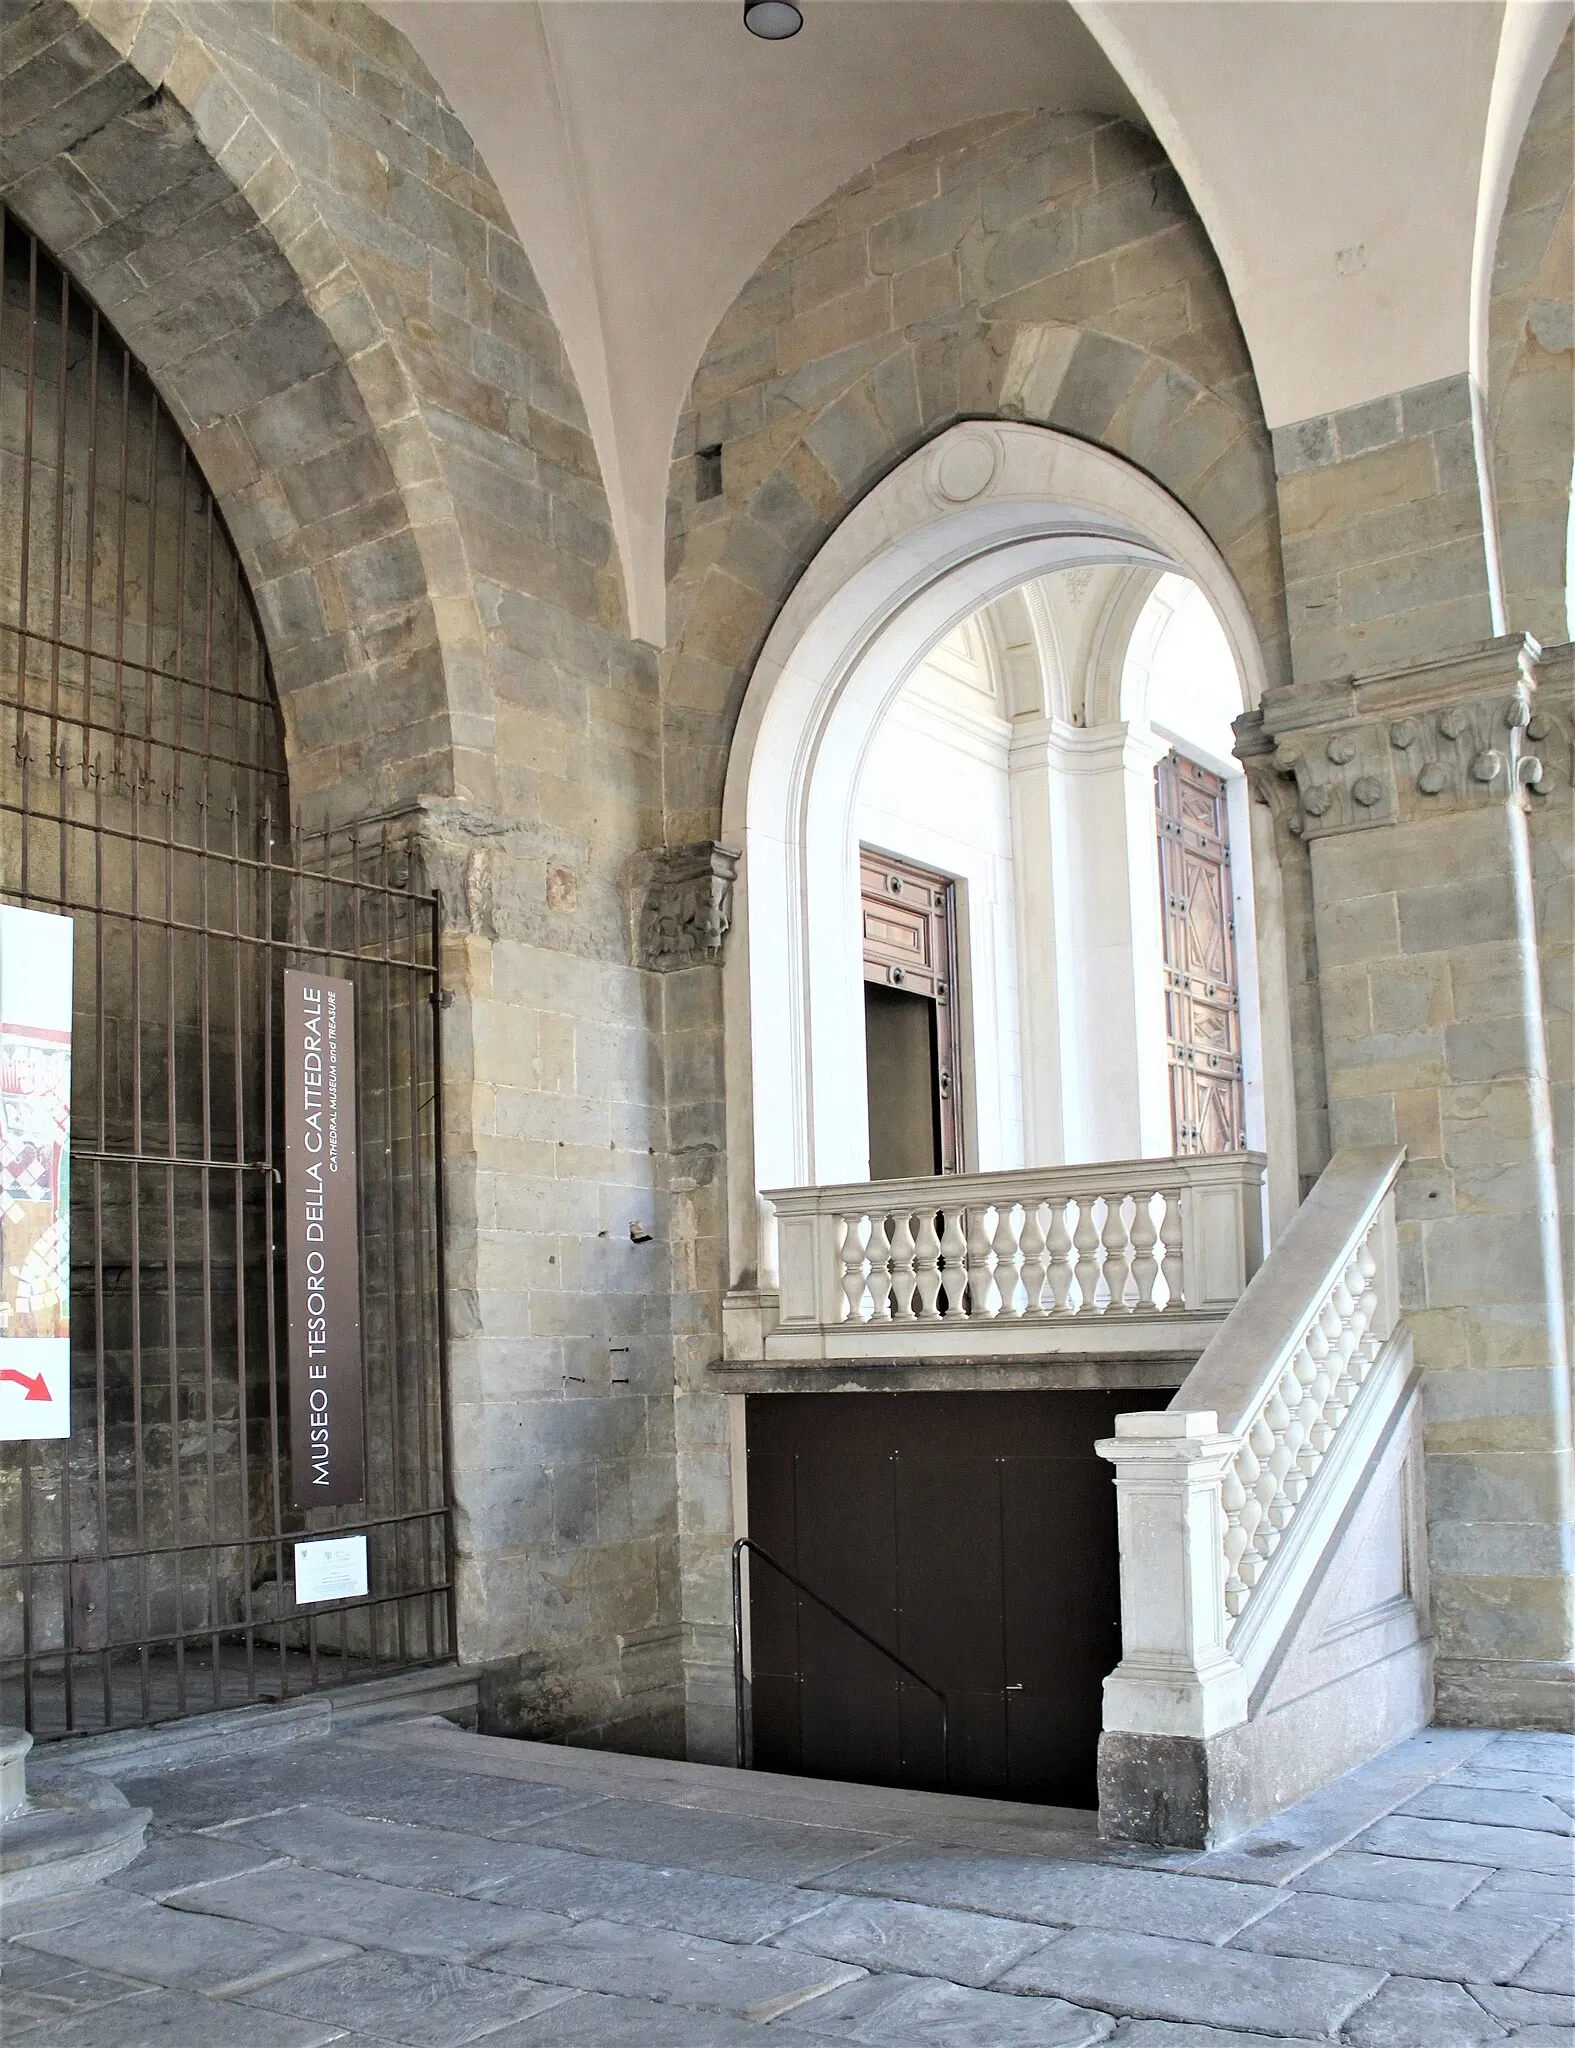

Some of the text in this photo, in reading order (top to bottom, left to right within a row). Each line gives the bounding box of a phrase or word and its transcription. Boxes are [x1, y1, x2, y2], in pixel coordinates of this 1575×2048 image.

[303, 987, 329, 1485] MUSEO E TESORO DELLA CATTEDRALE
[327, 991, 338, 1172] CATHEDRAL MUSEUM and TREASURE
